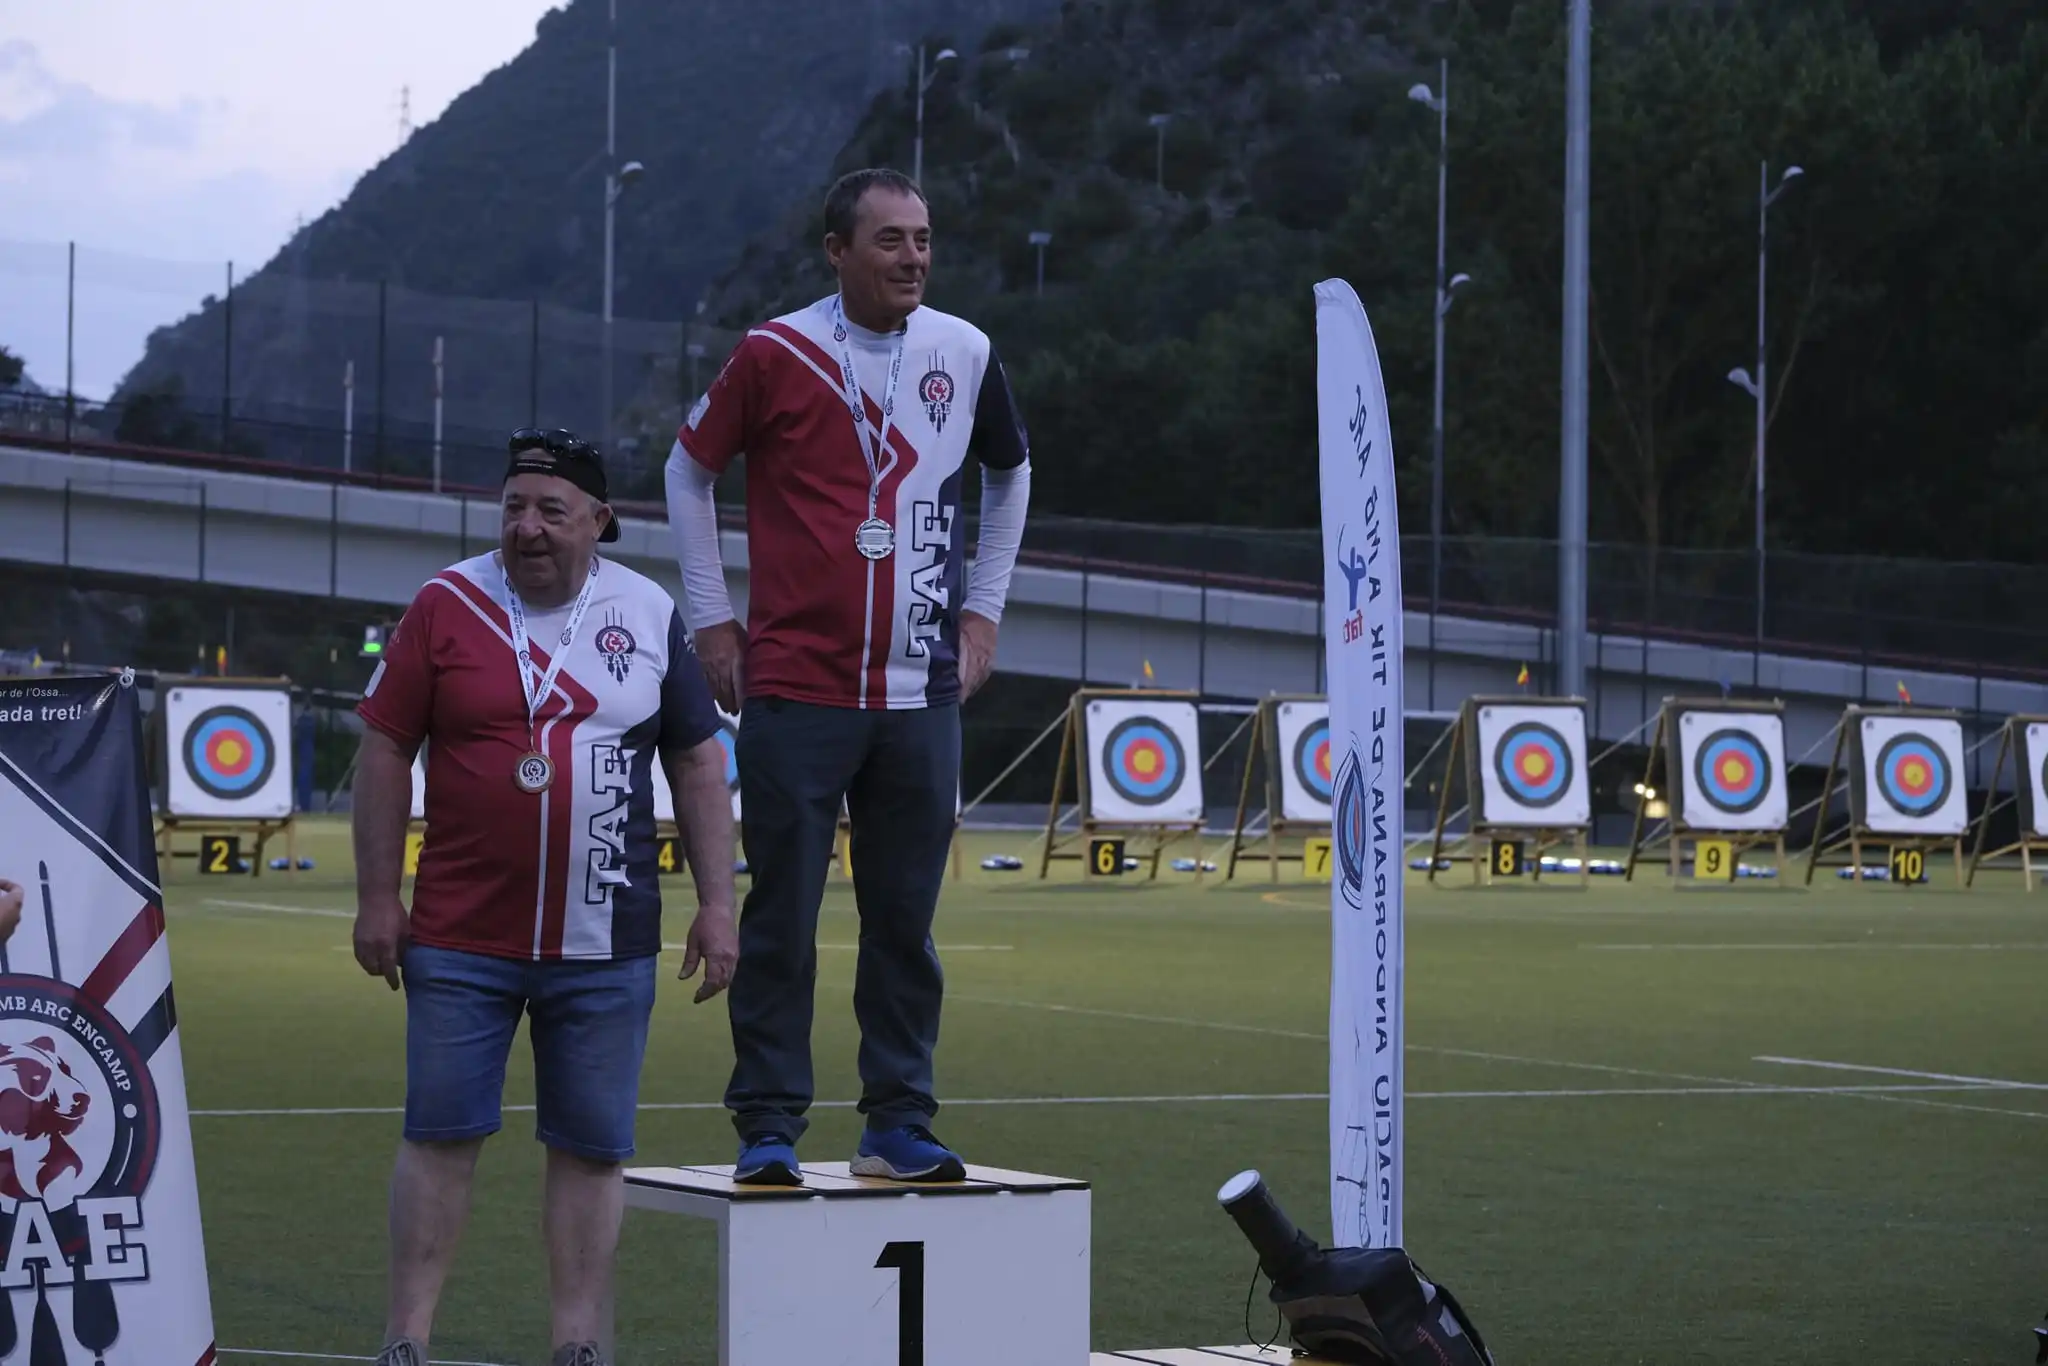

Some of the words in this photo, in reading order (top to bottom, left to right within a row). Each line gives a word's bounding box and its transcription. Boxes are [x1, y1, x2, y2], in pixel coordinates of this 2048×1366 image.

[906, 500, 956, 658] TAE
[599, 652, 634, 666] TAE
[10, 688, 23, 698] de
[41, 704, 82, 721] tret!
[585, 743, 637, 905] TAE
[209, 840, 229, 873] 2
[658, 840, 675, 872] 4
[1097, 843, 1115, 874] 6
[1315, 845, 1330, 872] 7
[1500, 844, 1515, 874] 8
[1706, 847, 1720, 873] 9
[1895, 850, 1922, 881] 10
[30, 998, 72, 1021] ARC
[71, 1014, 131, 1091] ENCAMP
[873, 1240, 924, 1366] 1
